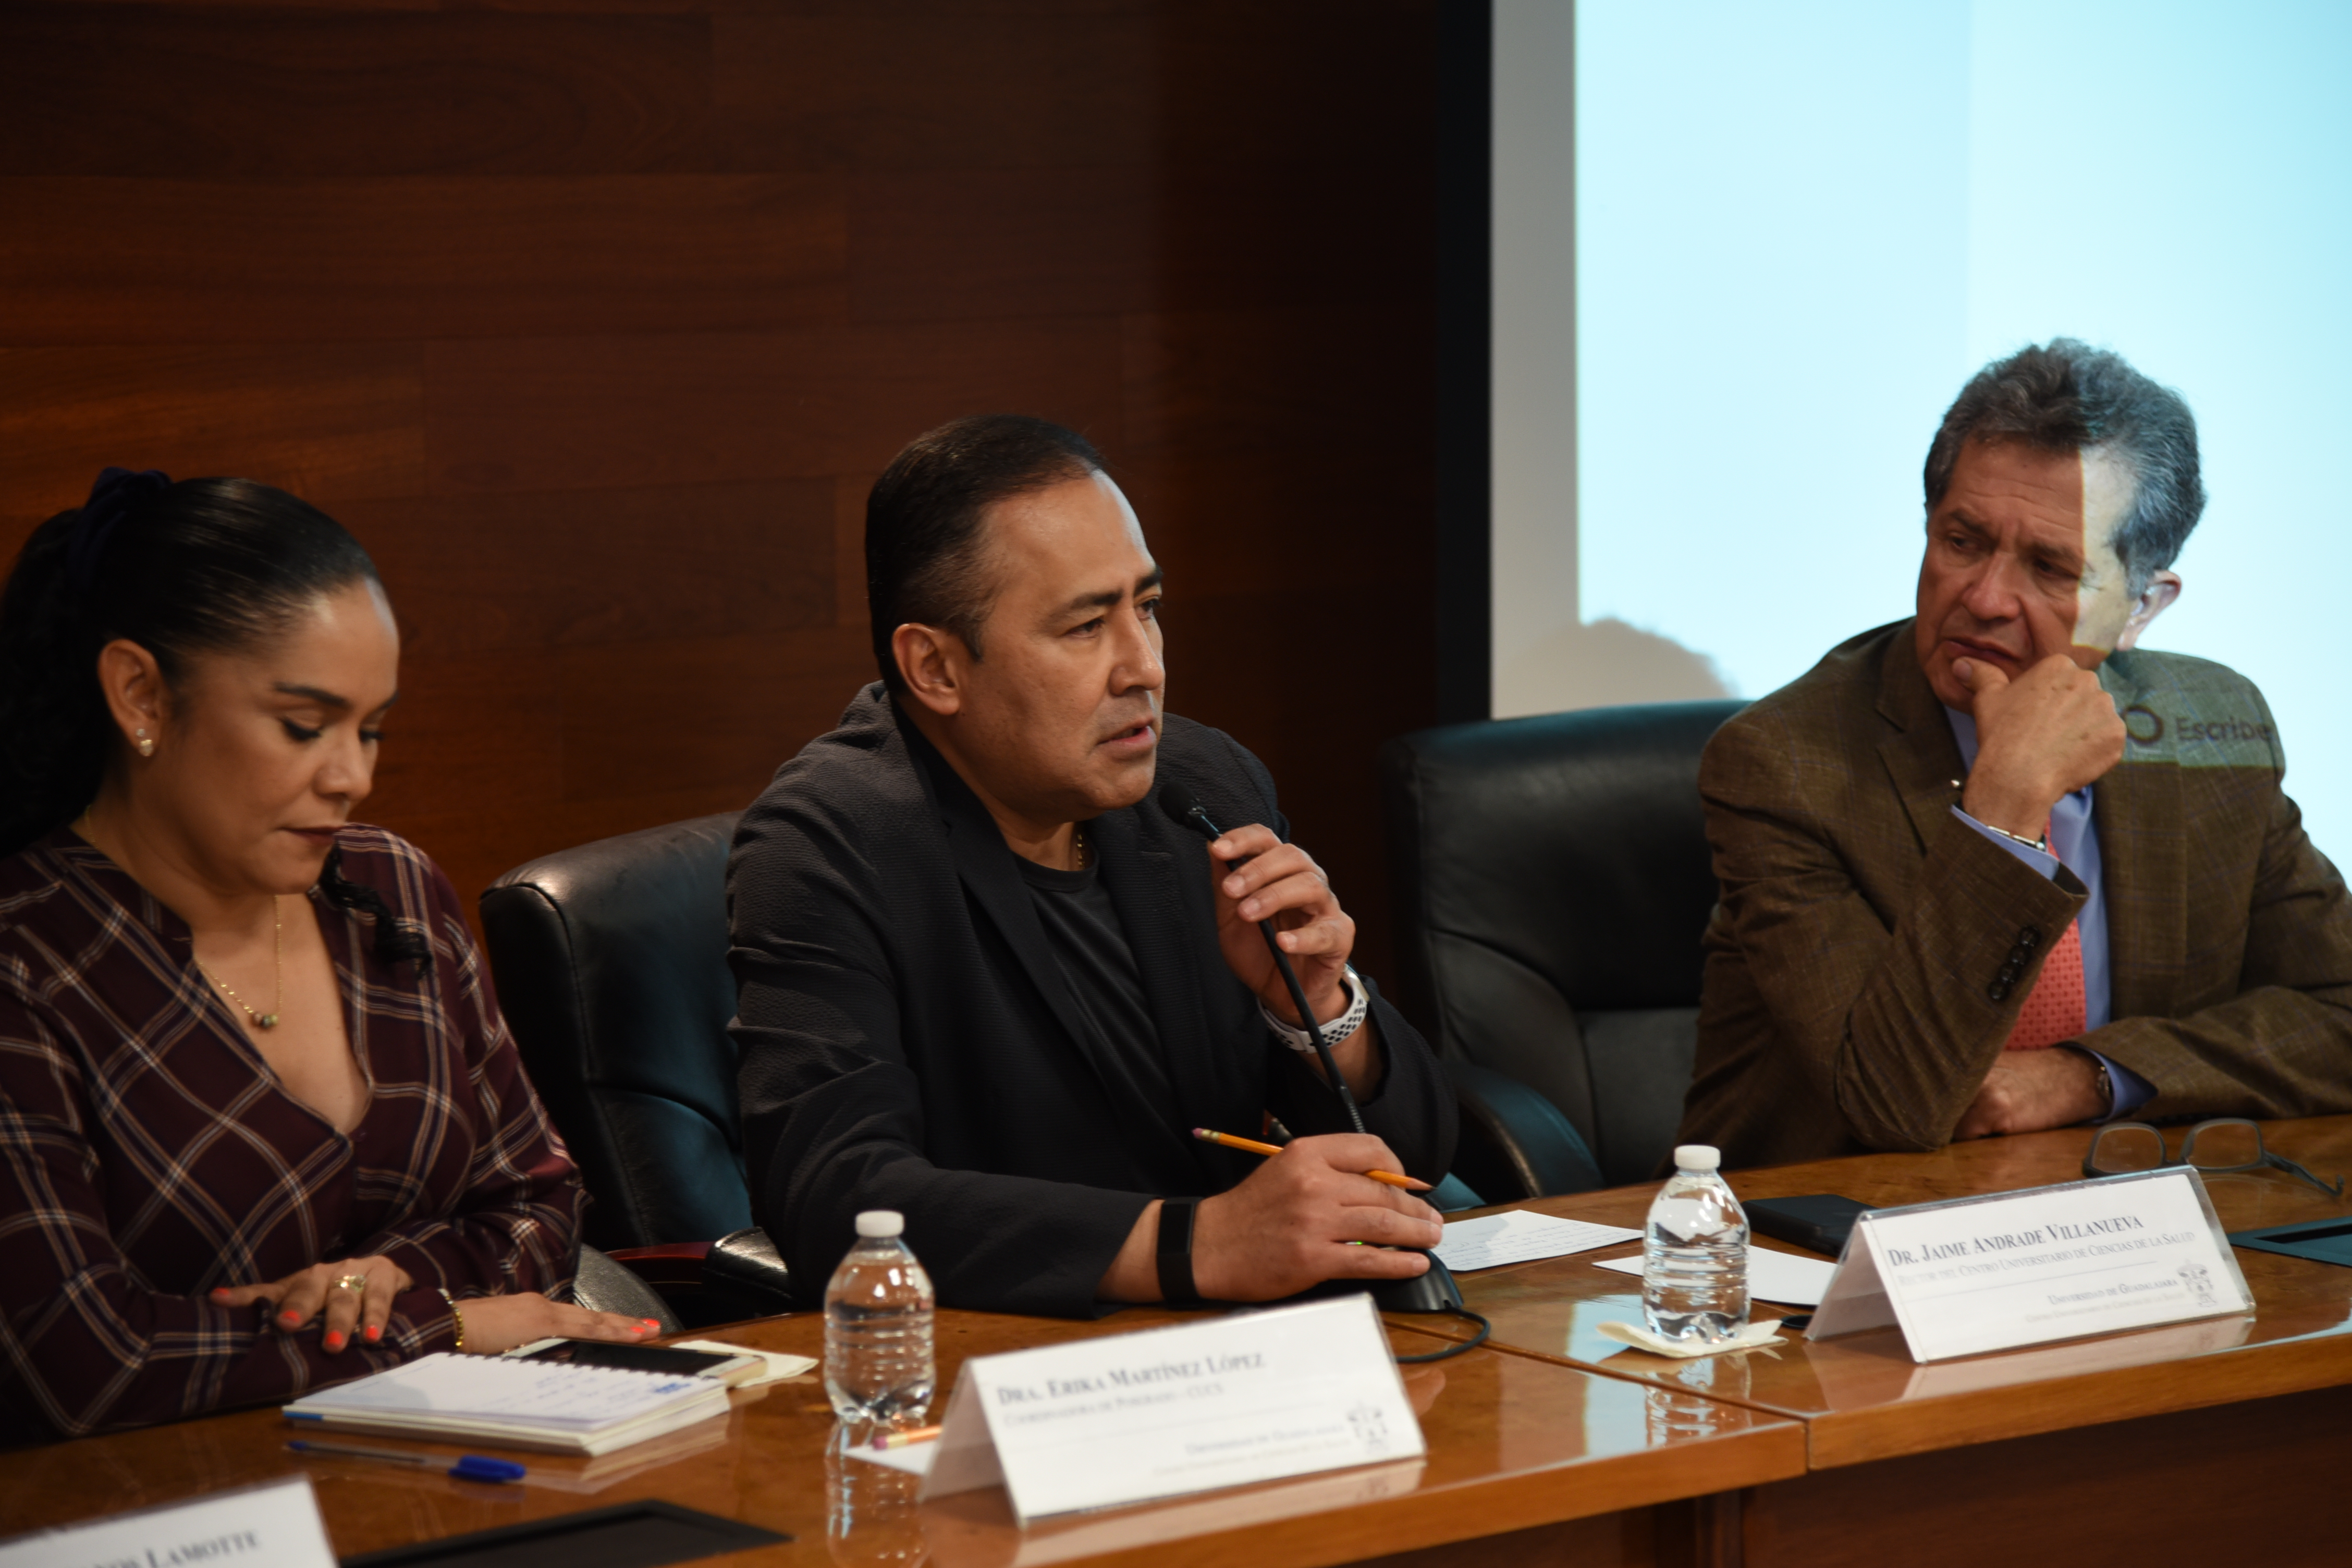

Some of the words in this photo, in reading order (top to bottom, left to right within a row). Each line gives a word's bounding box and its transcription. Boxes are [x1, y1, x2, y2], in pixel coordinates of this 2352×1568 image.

[1921, 1241, 1971, 1261] JAIME
[1974, 1230, 2046, 1253] ANDRADE
[2045, 1215, 2144, 1241] VILLANUEVA
